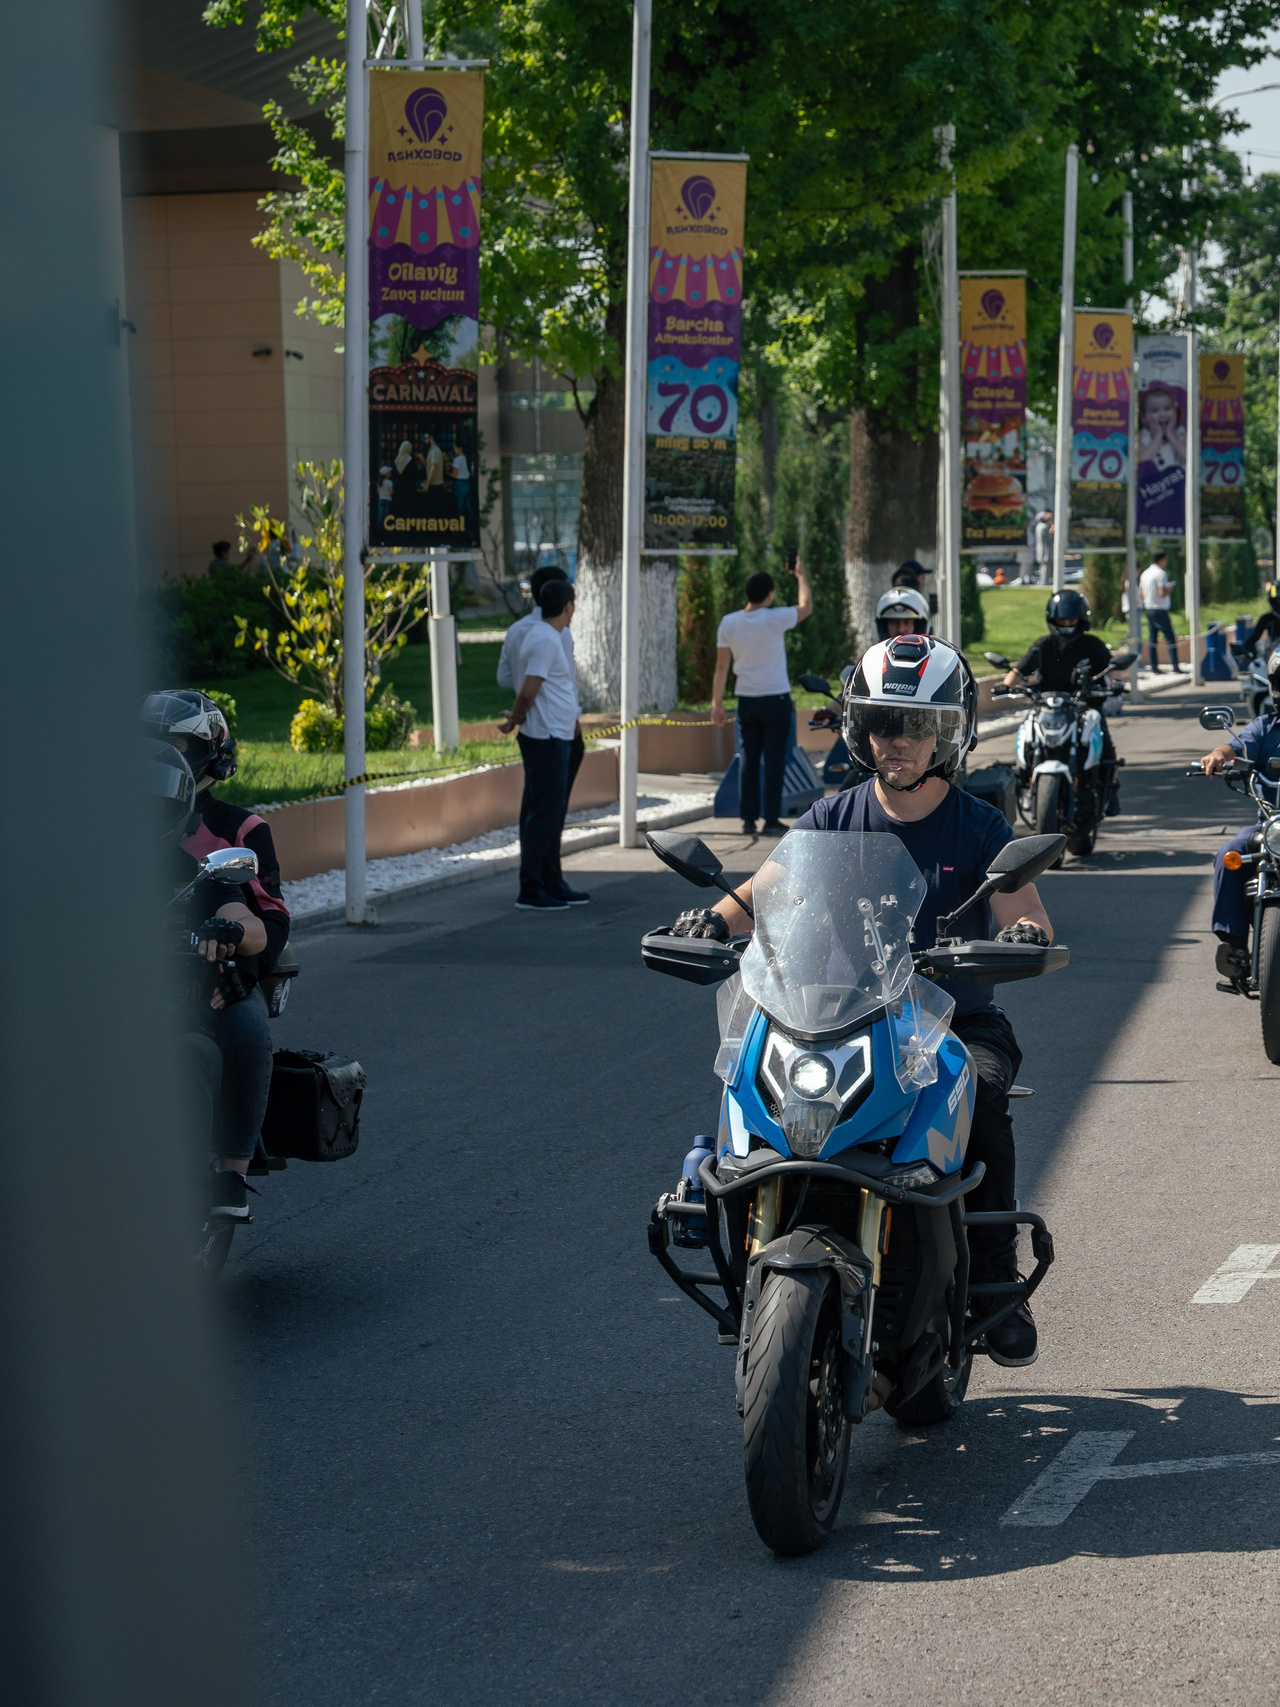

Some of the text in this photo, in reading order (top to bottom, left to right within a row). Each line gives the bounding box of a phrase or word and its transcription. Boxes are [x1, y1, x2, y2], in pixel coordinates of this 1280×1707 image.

[387, 148, 463, 163] ASHXOBOD
[666, 224, 729, 236] ASHXOBOD
[388, 262, 458, 285] Oilaviy
[381, 287, 464, 303] Zavq uchun
[665, 316, 725, 333] Barcha
[373, 383, 474, 403] CARNAVAL
[657, 381, 729, 434] 70
[1078, 449, 1122, 479] 70
[1204, 460, 1240, 485] 70
[383, 514, 466, 532] Carnaval
[883, 682, 917, 692] NOLAN
[948, 1061, 970, 1116] 650
